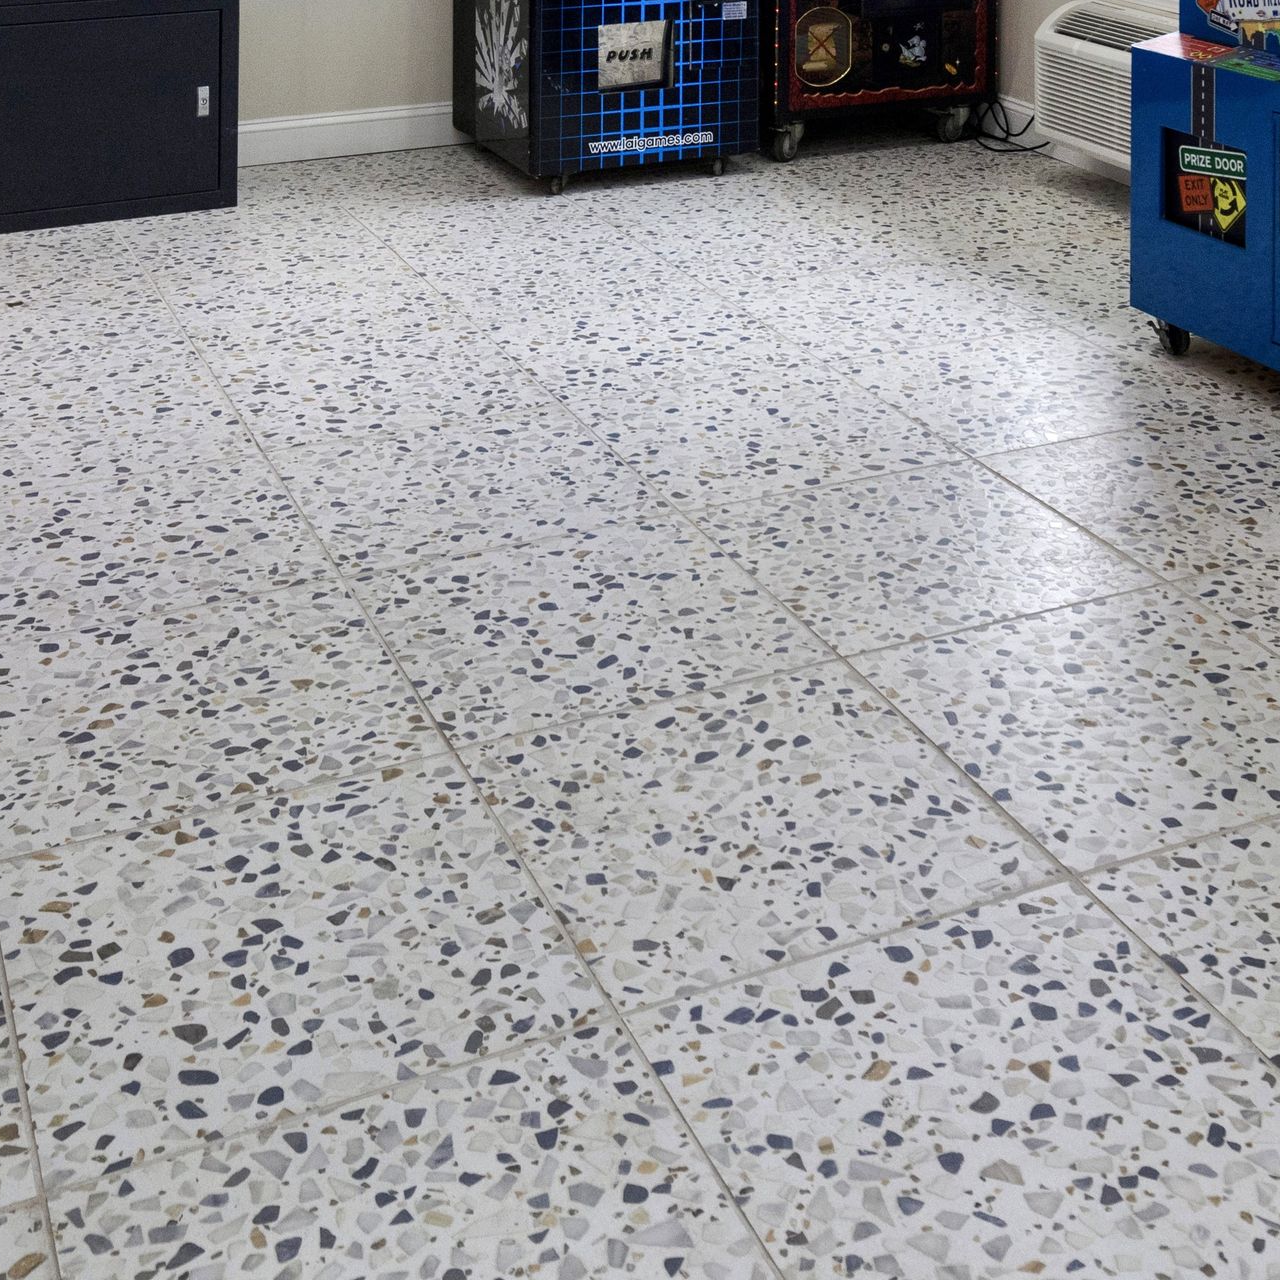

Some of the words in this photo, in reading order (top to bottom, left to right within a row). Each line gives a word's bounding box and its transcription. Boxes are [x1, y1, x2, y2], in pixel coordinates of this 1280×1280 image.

[605, 47, 654, 64] PUSH
[588, 131, 714, 154] www.laigames.com
[1184, 152, 1212, 169] PRIZE
[1214, 157, 1245, 174] DOOR
[1184, 178, 1205, 191] EXIT
[1185, 194, 1209, 207] ONLY
